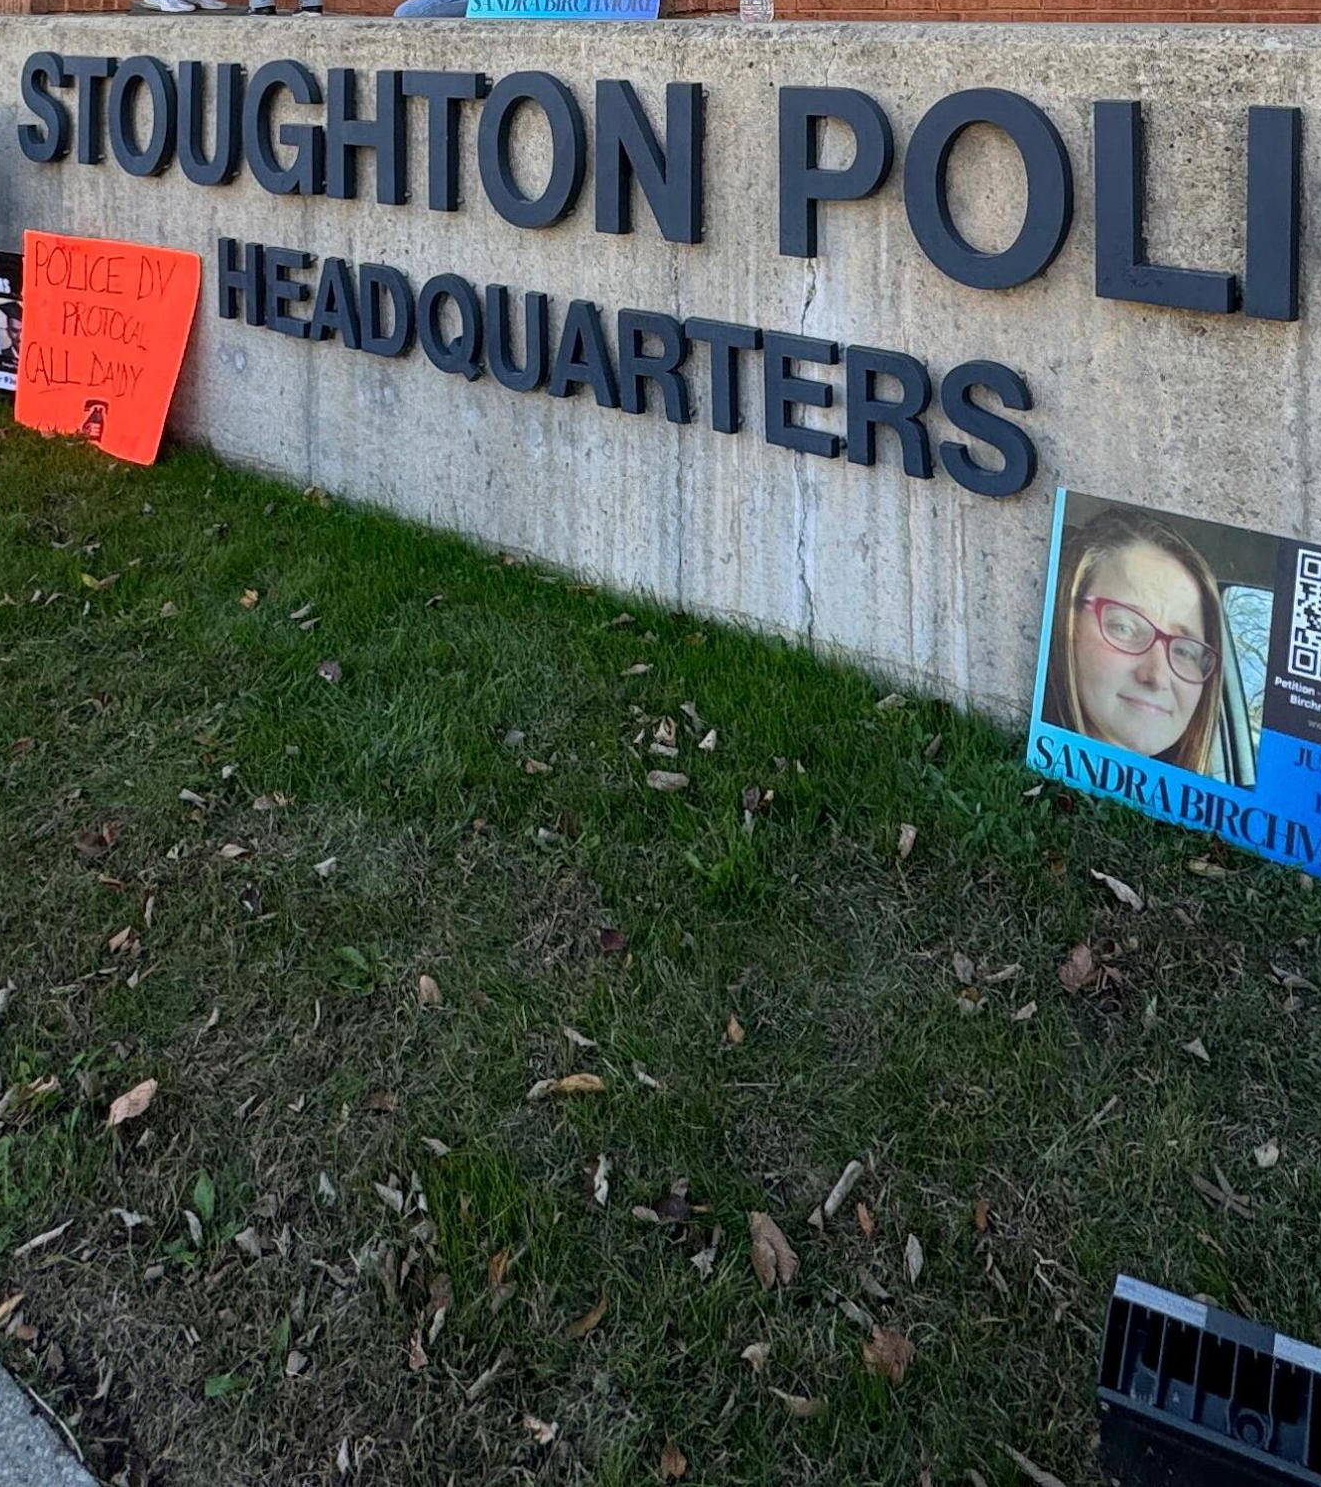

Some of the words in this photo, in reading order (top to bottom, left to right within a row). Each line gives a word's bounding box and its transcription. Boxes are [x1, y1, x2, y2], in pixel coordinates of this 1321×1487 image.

[18, 51, 706, 245] STOUGHTON
[35, 240, 126, 295] POLICE
[137, 254, 176, 301] DV
[24, 341, 81, 386] CALL
[218, 236, 1038, 498] HEADQUARTERS
[1274, 675, 1316, 697] Petition
[1033, 735, 1173, 814] SANDRA
